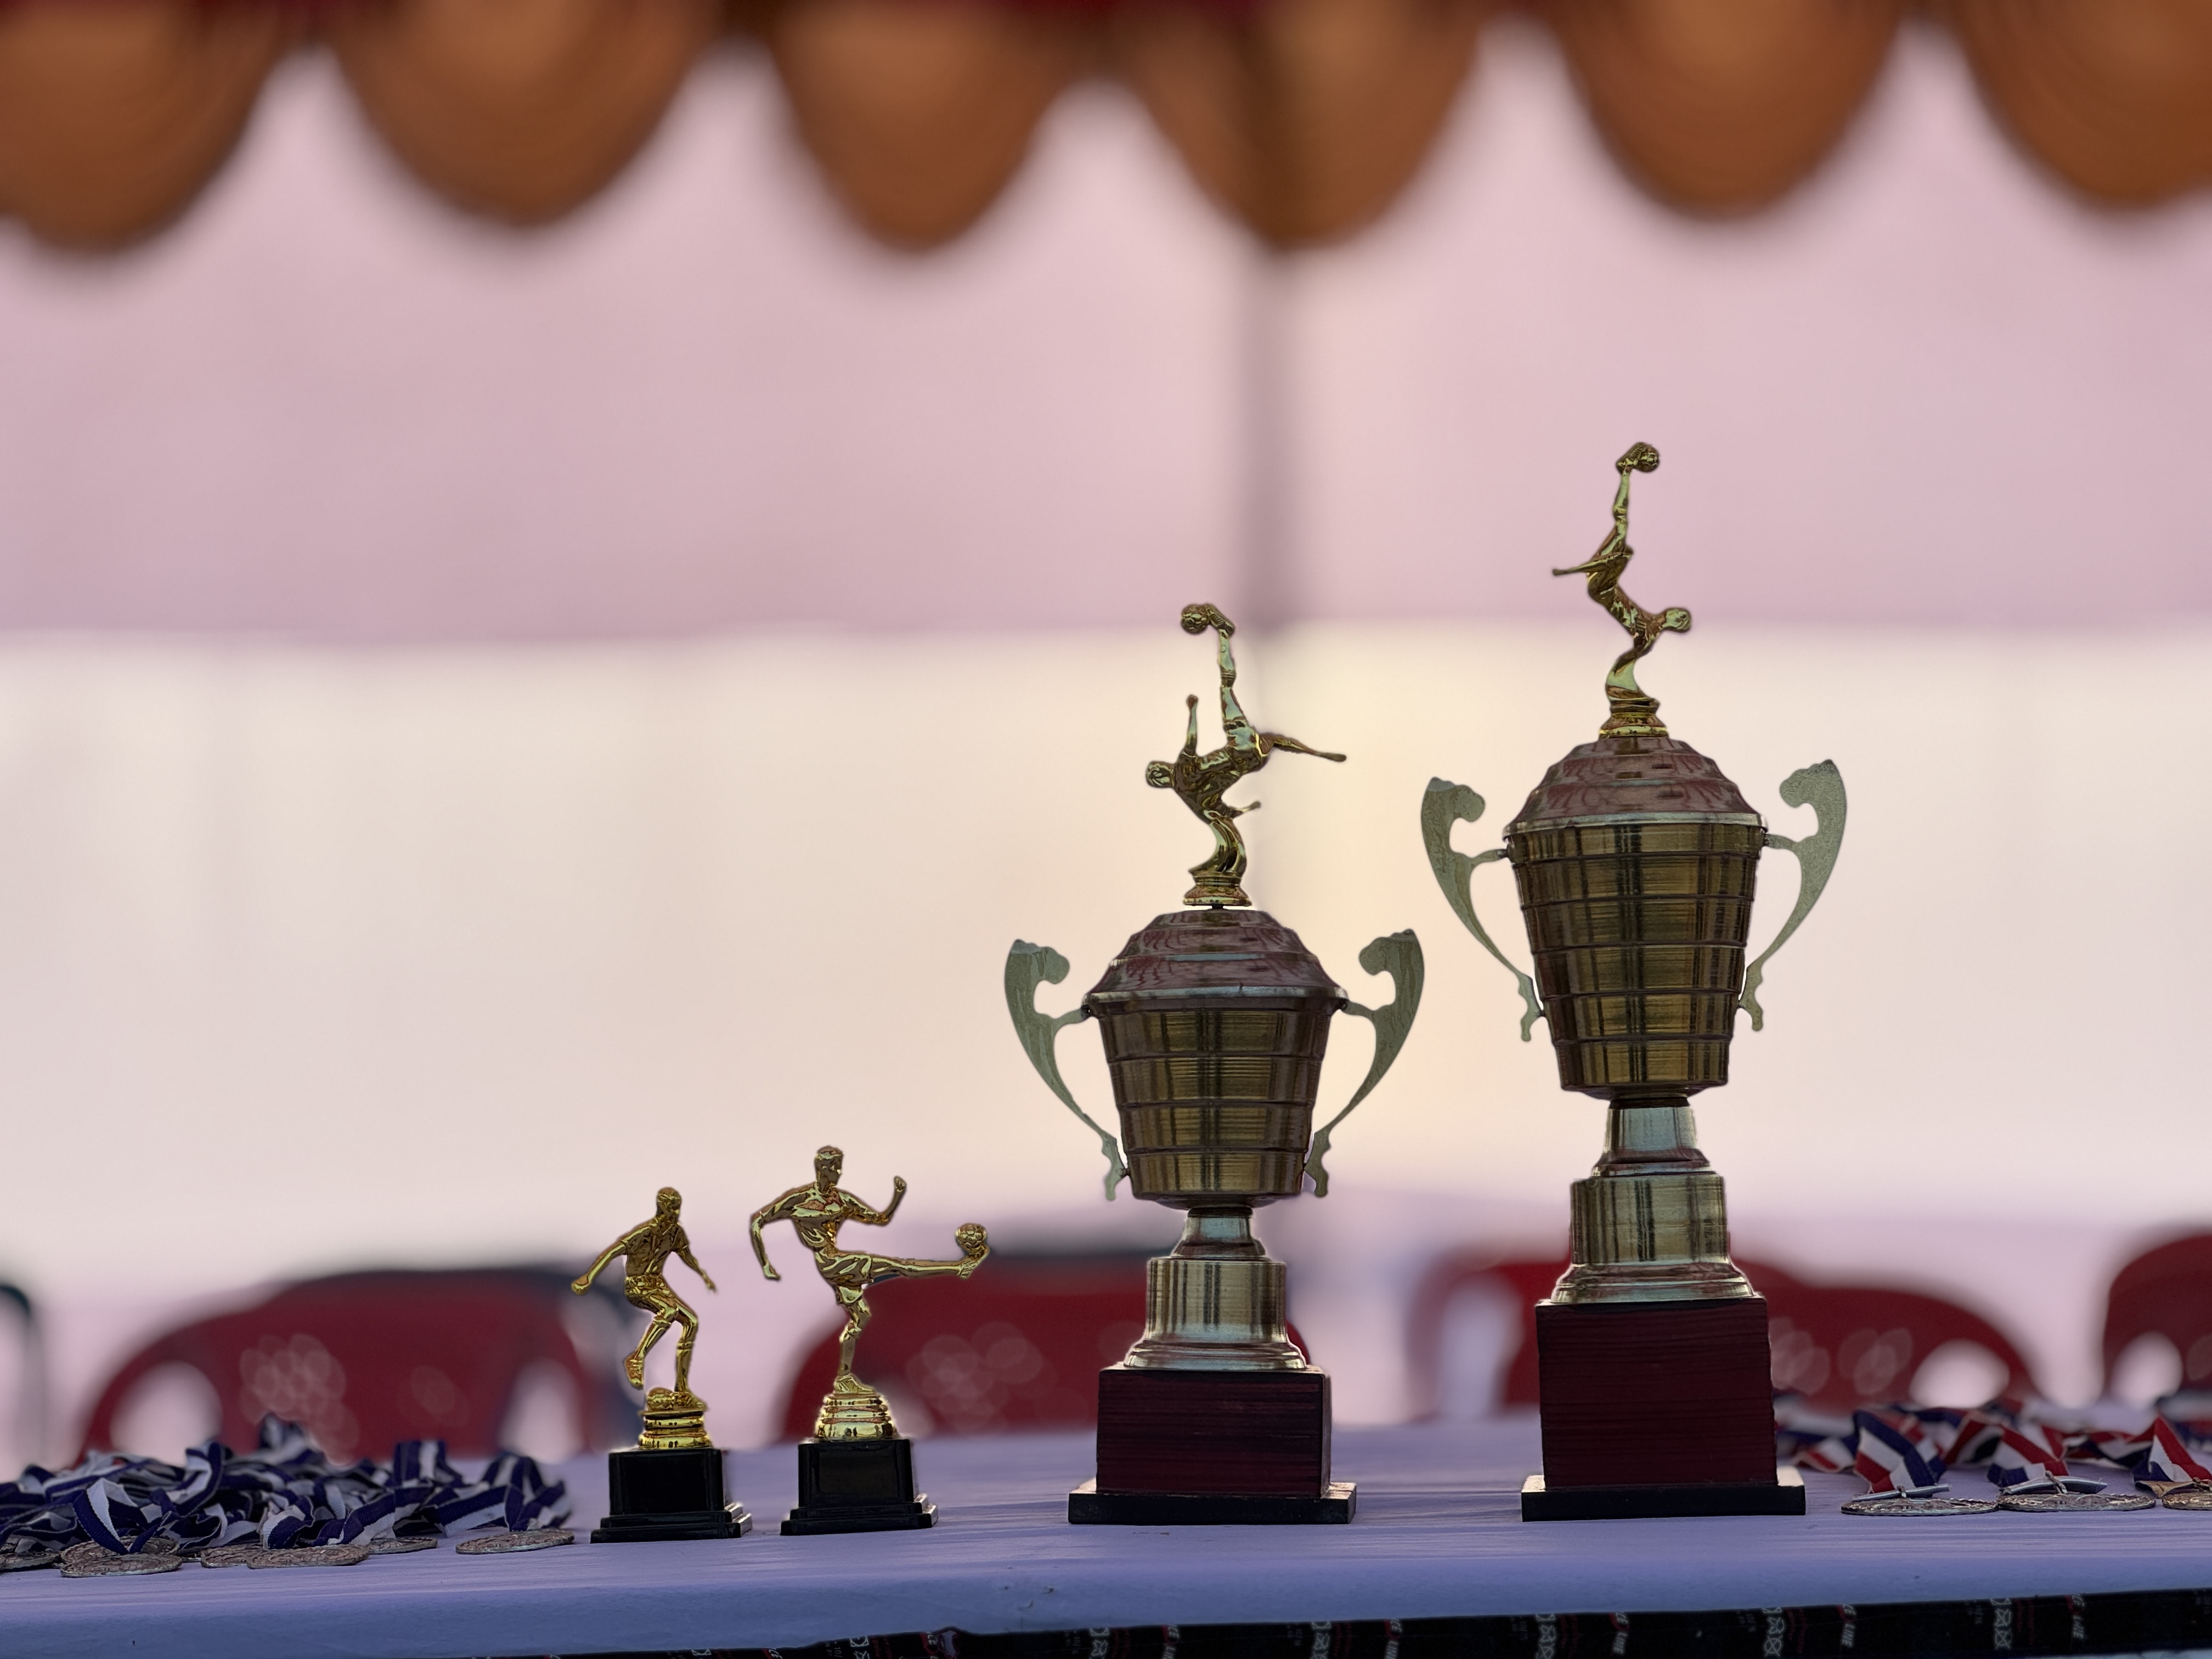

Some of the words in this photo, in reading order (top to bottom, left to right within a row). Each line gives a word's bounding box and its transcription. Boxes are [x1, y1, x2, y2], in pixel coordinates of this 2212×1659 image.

[925, 1632, 938, 1645] CE
[1611, 1632, 1628, 1655] LINE
[1840, 1623, 1855, 1647] LINE
